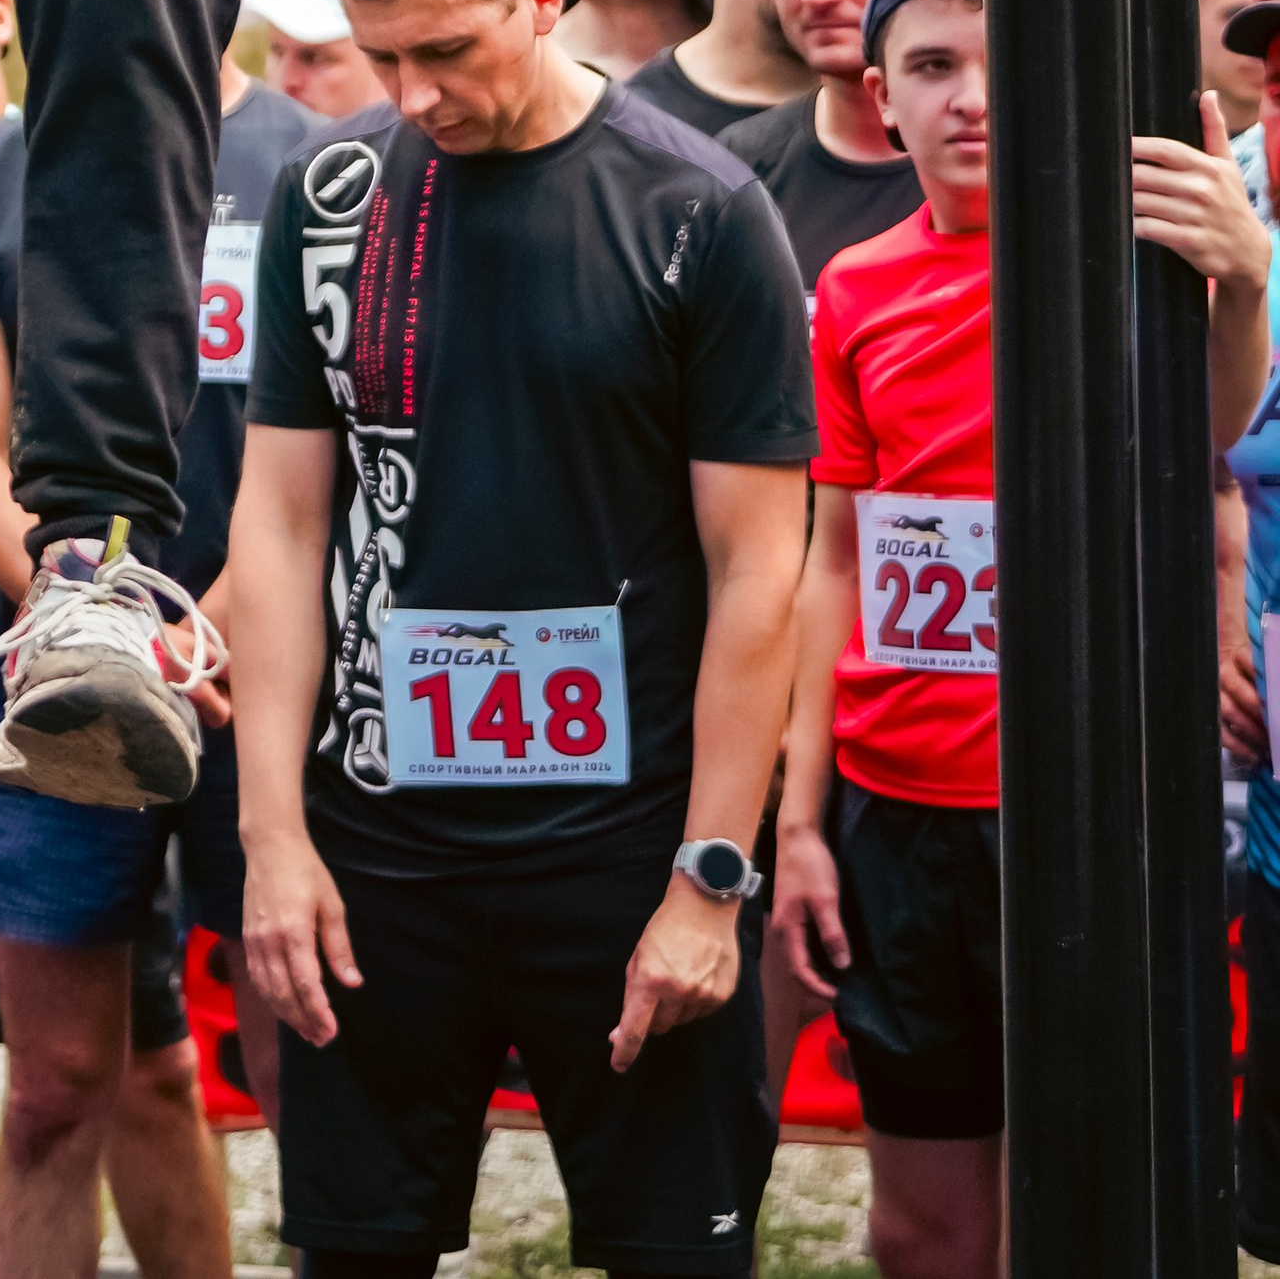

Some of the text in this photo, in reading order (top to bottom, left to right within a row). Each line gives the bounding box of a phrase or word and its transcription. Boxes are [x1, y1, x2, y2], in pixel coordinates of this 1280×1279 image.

[875, 538, 950, 559] BOGAL
[408, 647, 516, 666] BOGAL
[408, 666, 607, 759] 148
[408, 762, 612, 775] СПОРТИВНЫЙ МАРАФОН 2026
